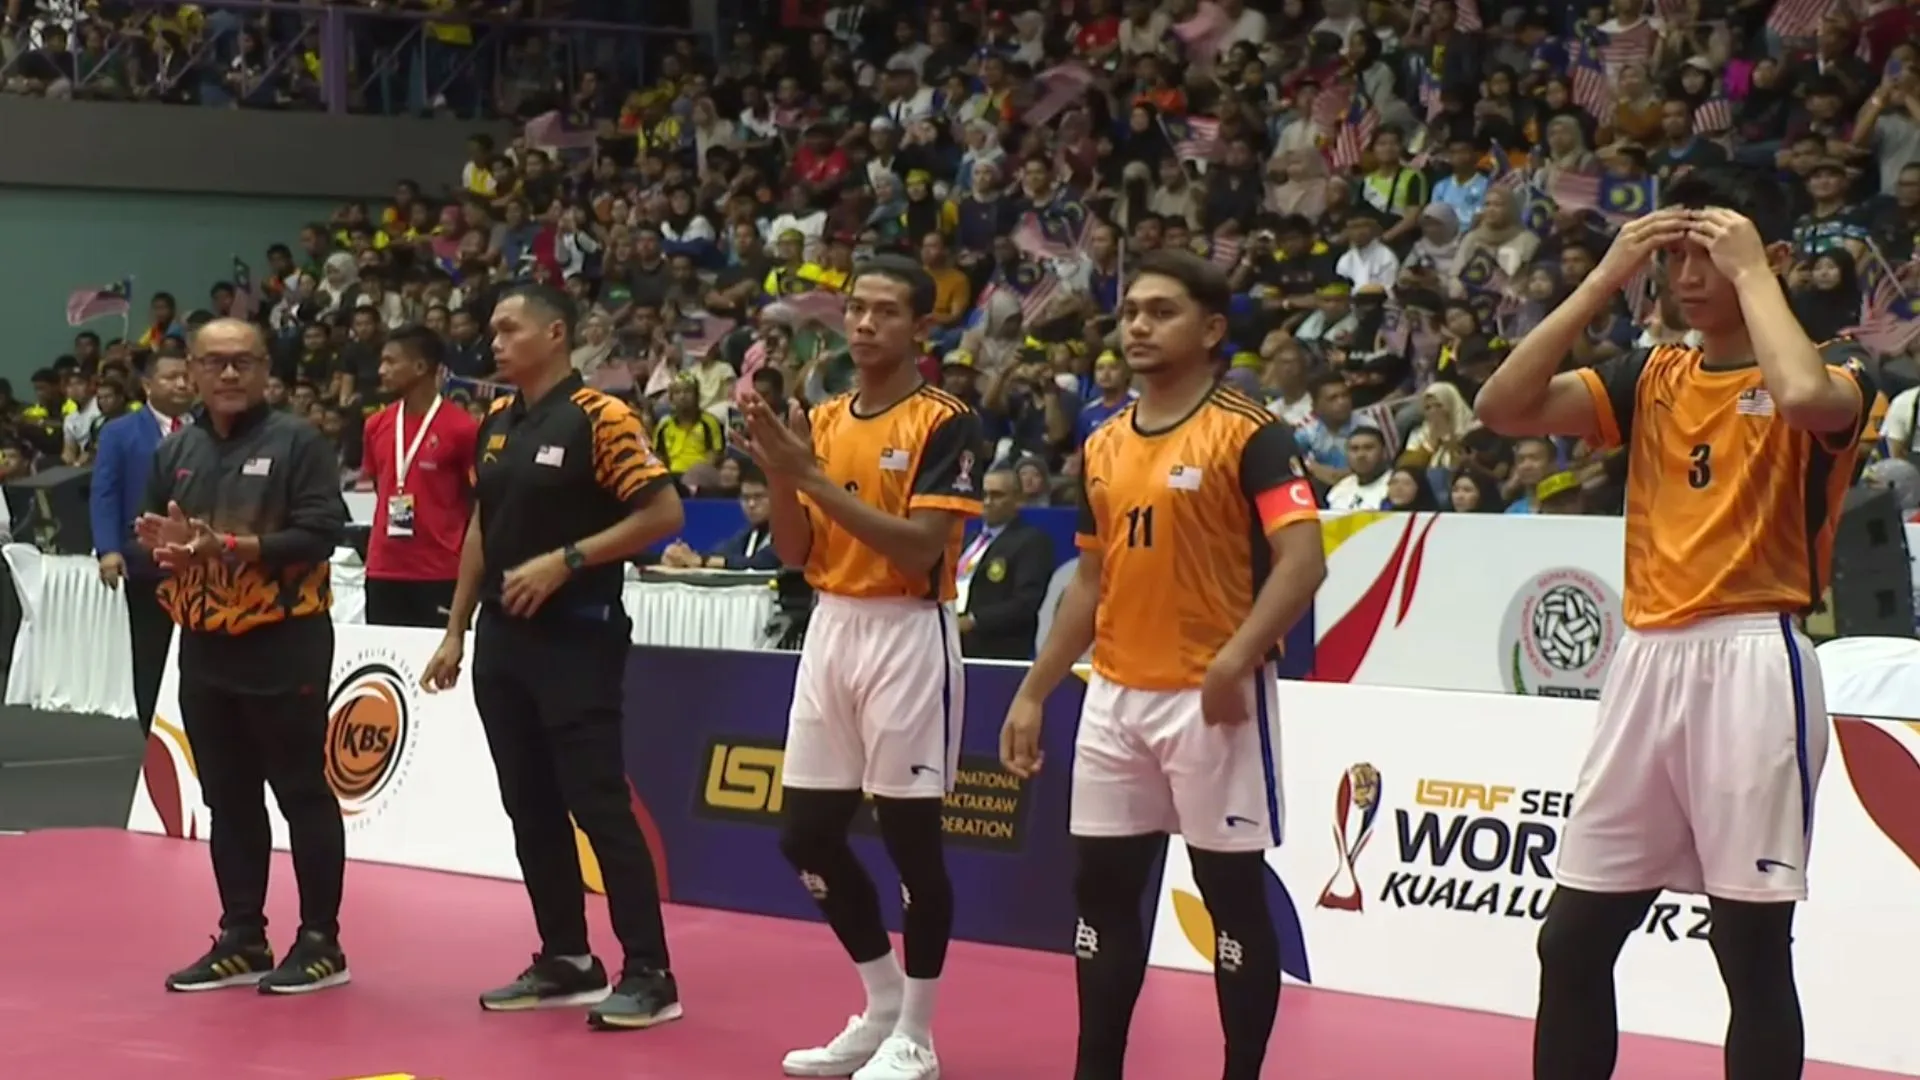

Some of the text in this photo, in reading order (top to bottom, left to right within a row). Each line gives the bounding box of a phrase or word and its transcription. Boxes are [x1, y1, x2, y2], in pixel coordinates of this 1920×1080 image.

[1687, 443, 1711, 489] 3
[1289, 484, 1310, 505] C
[1126, 505, 1154, 548] 11
[342, 722, 393, 759] KBS
[942, 791, 1018, 815] AKTAKRAW
[1395, 808, 1557, 879] WOR
[1379, 871, 1501, 914] KUALA
